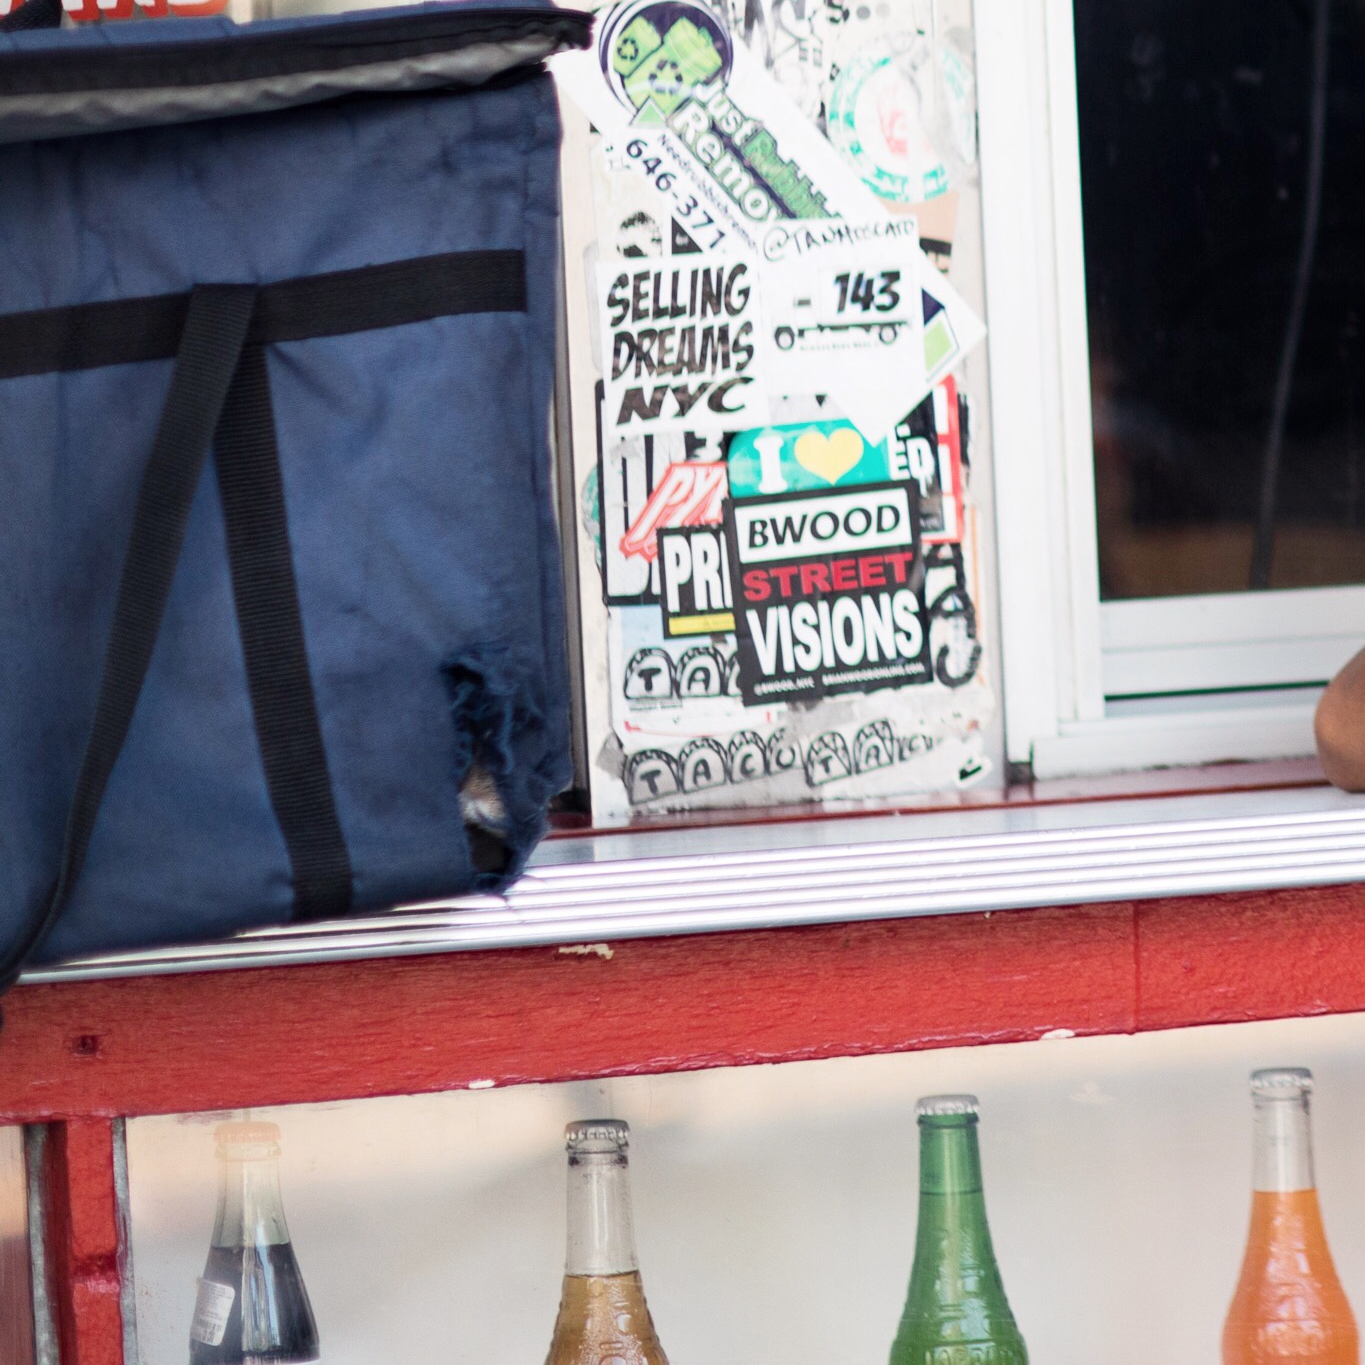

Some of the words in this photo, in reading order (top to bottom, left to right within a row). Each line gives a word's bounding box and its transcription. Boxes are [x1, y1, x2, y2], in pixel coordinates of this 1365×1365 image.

[692, 76, 763, 147] Just
[607, 263, 750, 327] SELLING
[834, 270, 900, 314] 143
[611, 321, 754, 381] DREAMS
[616, 377, 754, 425] NYC
[753, 435, 788, 493] I
[748, 504, 901, 549] BWOOD
[743, 552, 912, 602] STREET
[746, 588, 924, 676] VISIONS
